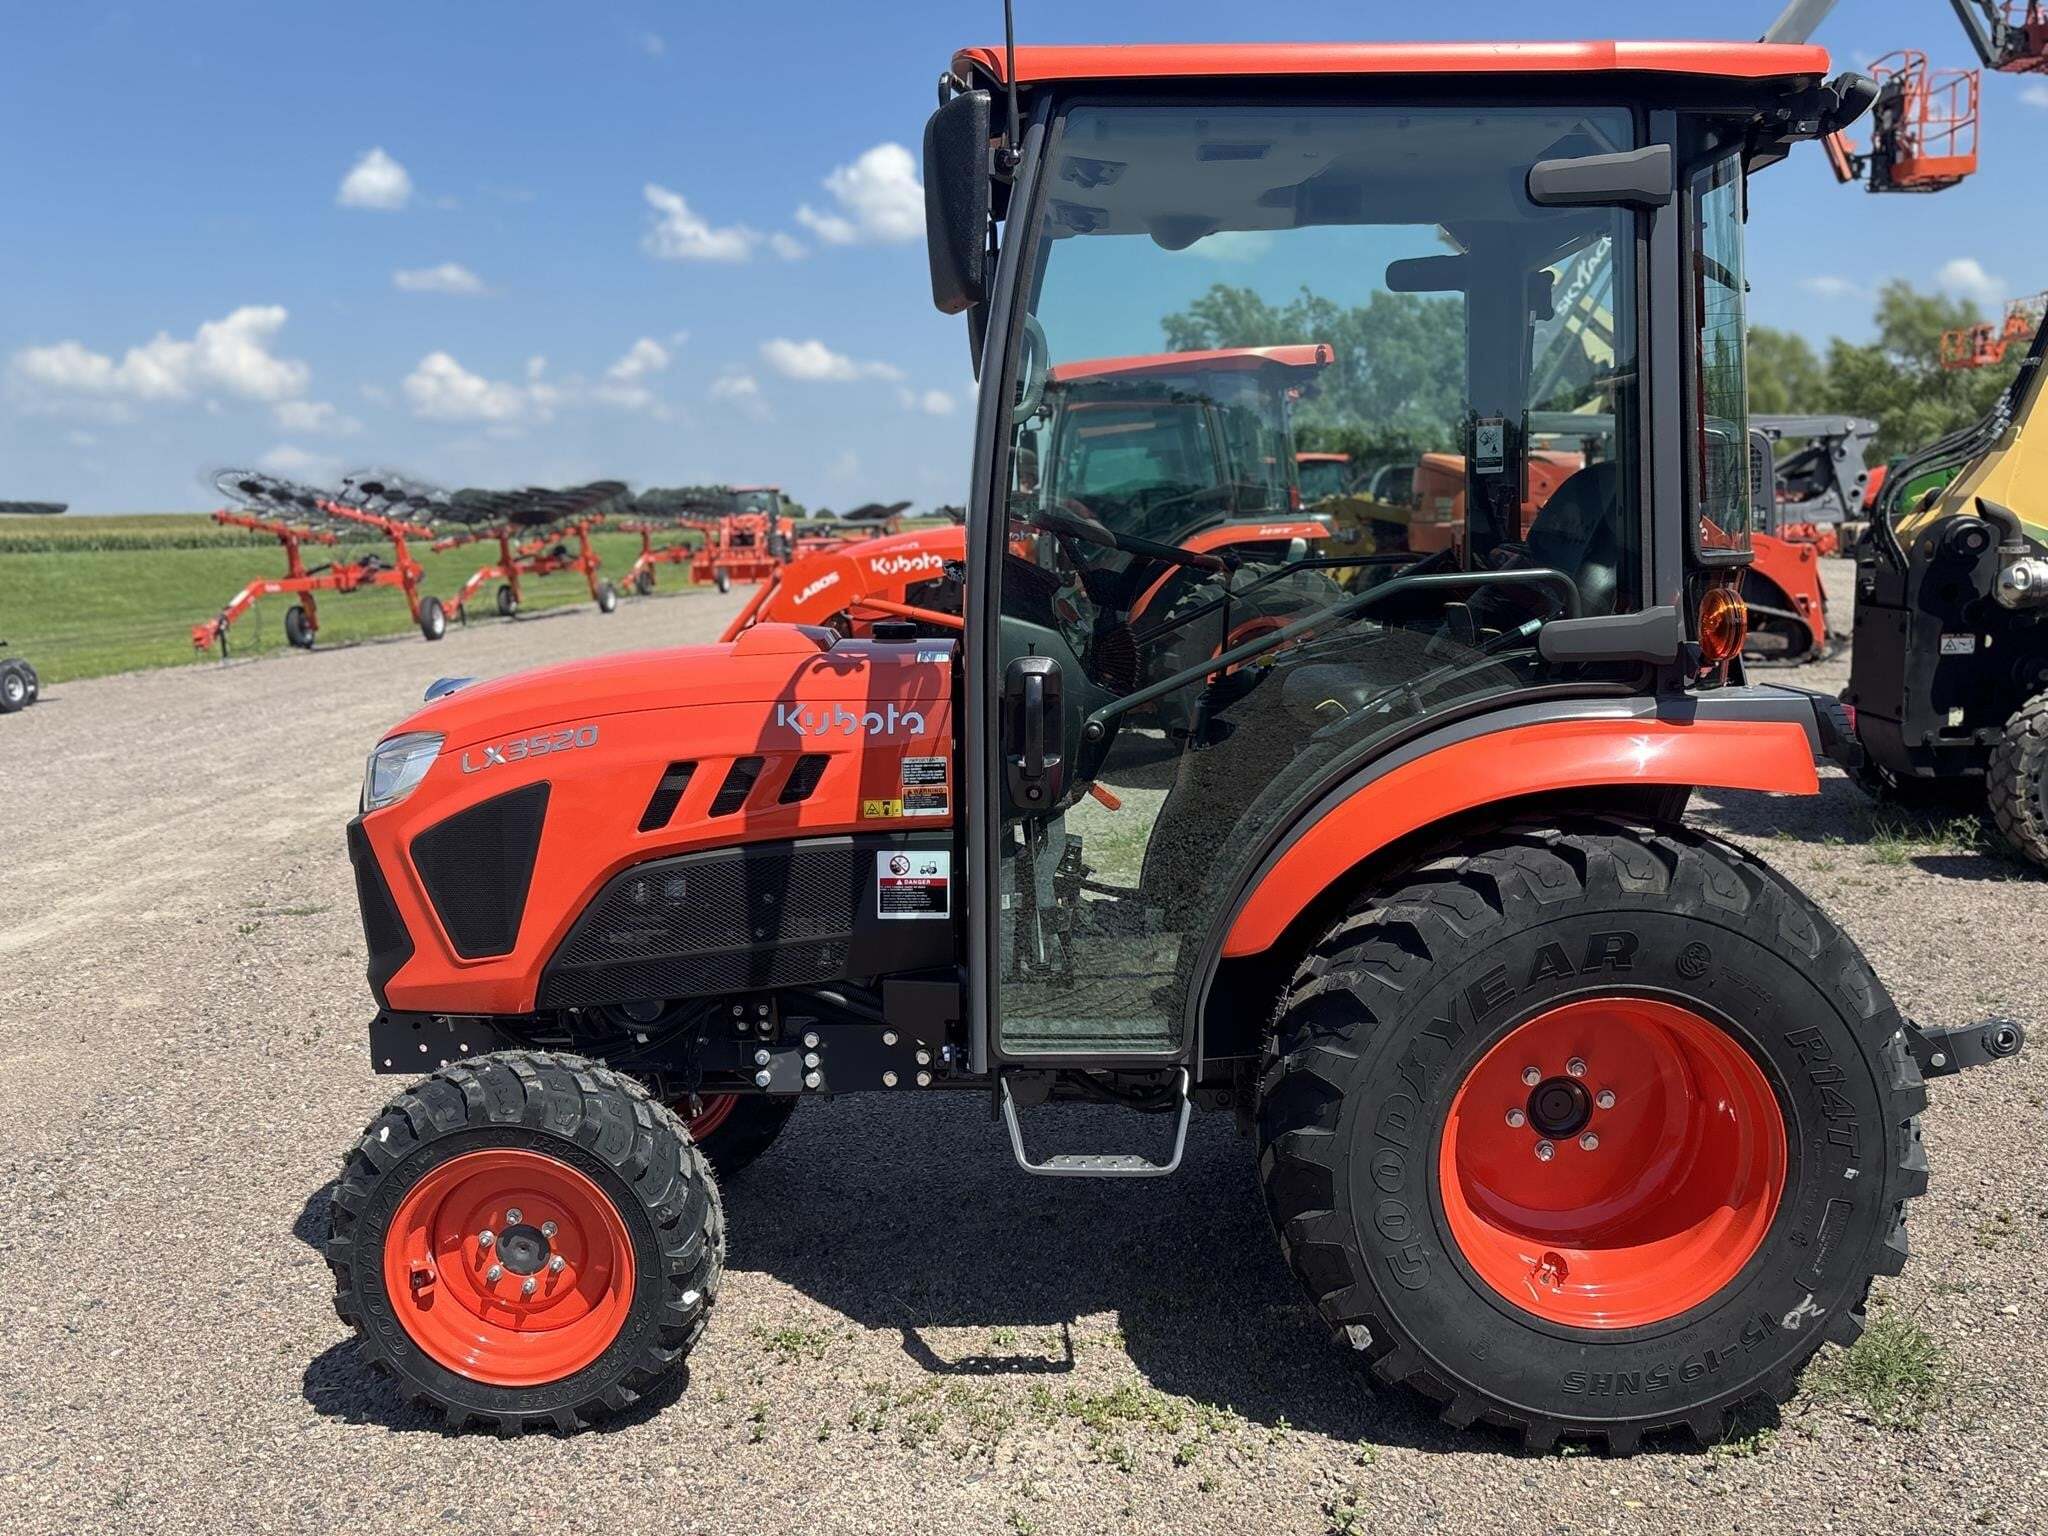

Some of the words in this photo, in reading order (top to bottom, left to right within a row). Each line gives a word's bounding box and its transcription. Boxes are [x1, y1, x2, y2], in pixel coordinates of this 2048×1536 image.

[871, 552, 943, 575] Kubota
[777, 703, 925, 735] Kubota
[462, 725, 599, 774] LX3520
[1784, 1025, 1862, 1159] R14T
